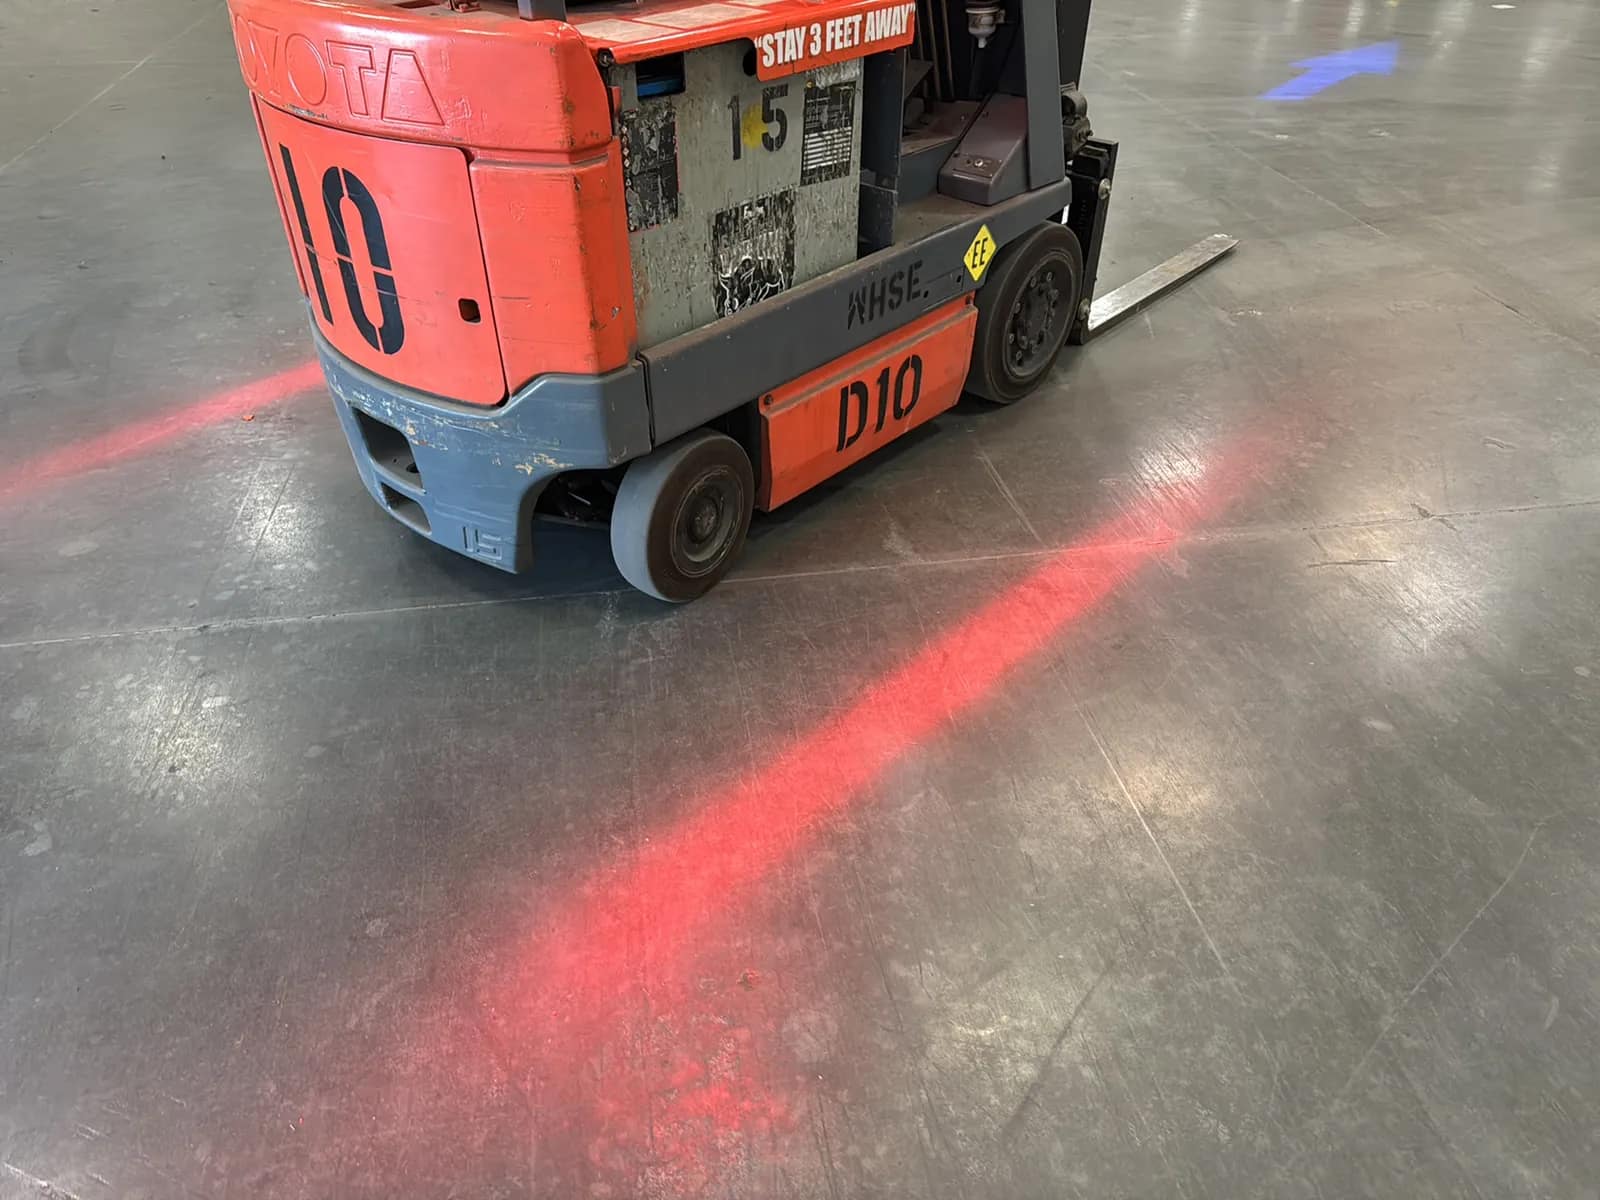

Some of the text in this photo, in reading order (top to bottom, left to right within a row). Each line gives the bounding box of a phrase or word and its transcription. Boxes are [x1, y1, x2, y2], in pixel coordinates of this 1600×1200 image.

[809, 23, 822, 56] 3
[826, 14, 863, 52] FEET
[279, 142, 405, 355] 10
[970, 237, 989, 269] EE
[847, 260, 929, 331] WHSE.
[836, 354, 923, 453] D10
